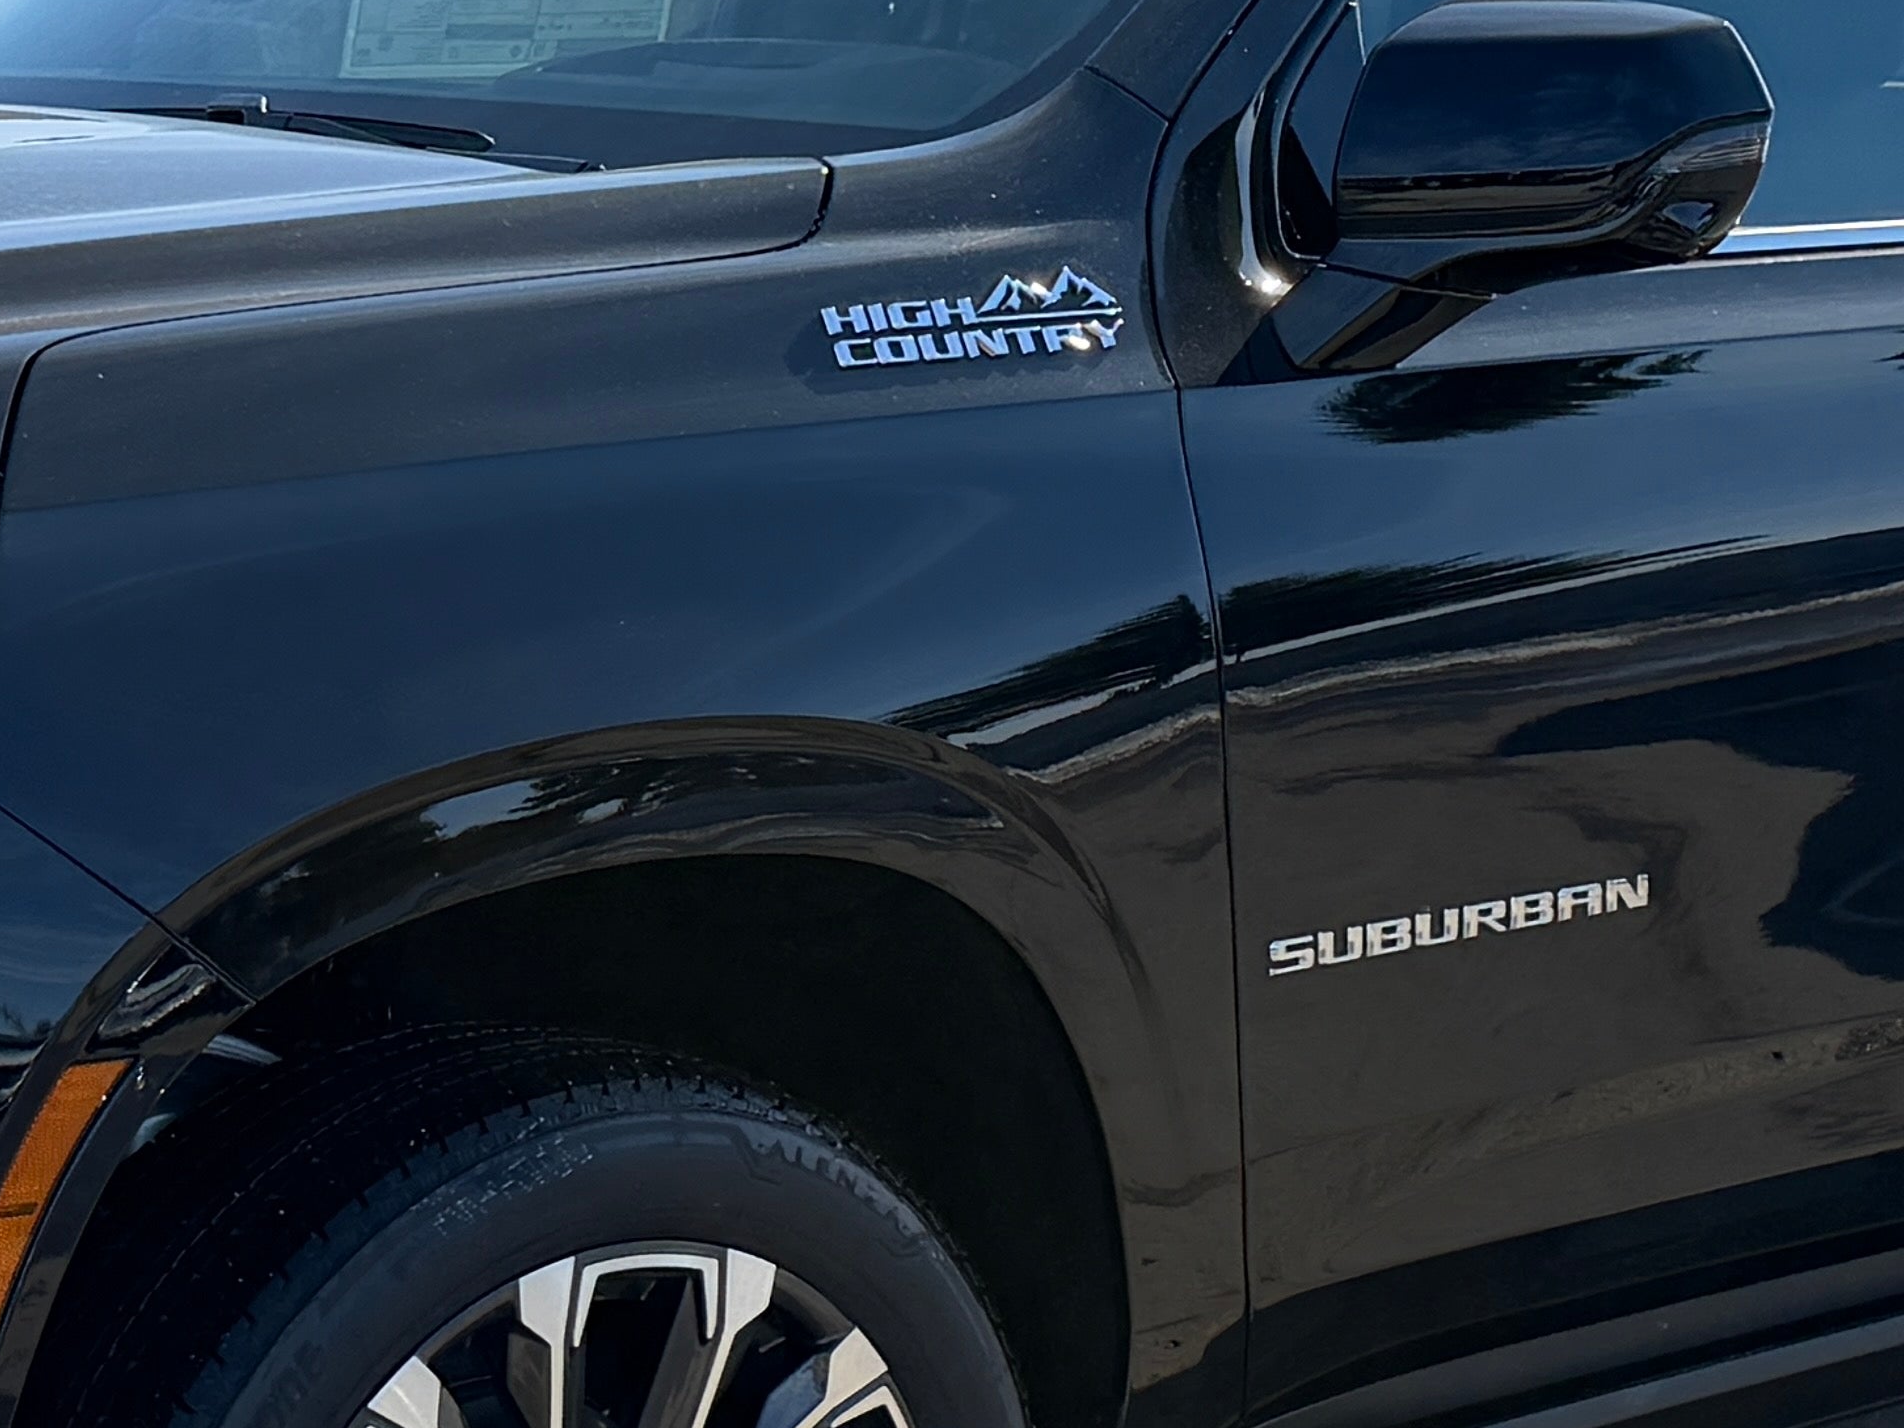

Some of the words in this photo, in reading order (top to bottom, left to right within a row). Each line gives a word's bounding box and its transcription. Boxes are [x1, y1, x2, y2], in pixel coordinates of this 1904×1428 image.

[820, 296, 980, 336] HIGH
[833, 318, 1125, 368] COUNTRY
[1268, 873, 1650, 977] SUBURBAN
